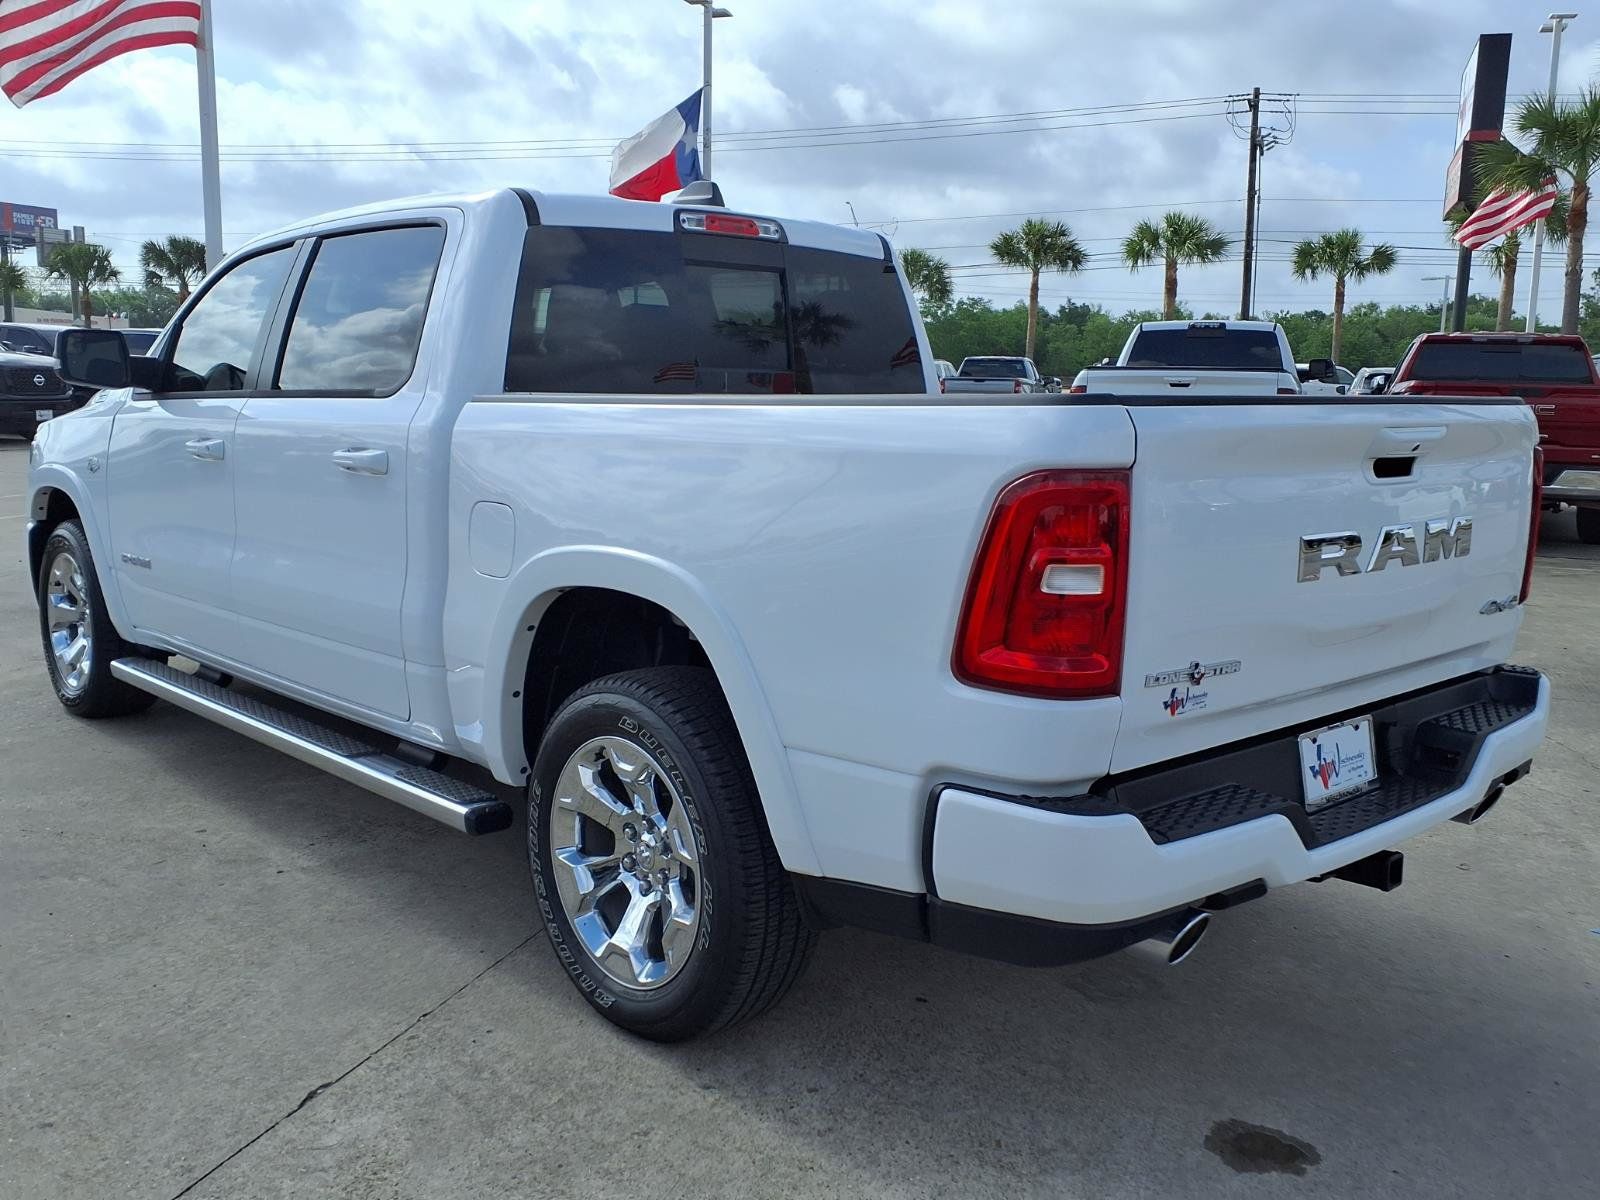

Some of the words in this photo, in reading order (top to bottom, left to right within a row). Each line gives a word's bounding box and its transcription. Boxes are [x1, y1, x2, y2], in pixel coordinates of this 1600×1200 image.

[1297, 516, 1472, 583] RAM
[618, 716, 708, 856] DUELER
[528, 779, 617, 1009] BRIDGESTONE
